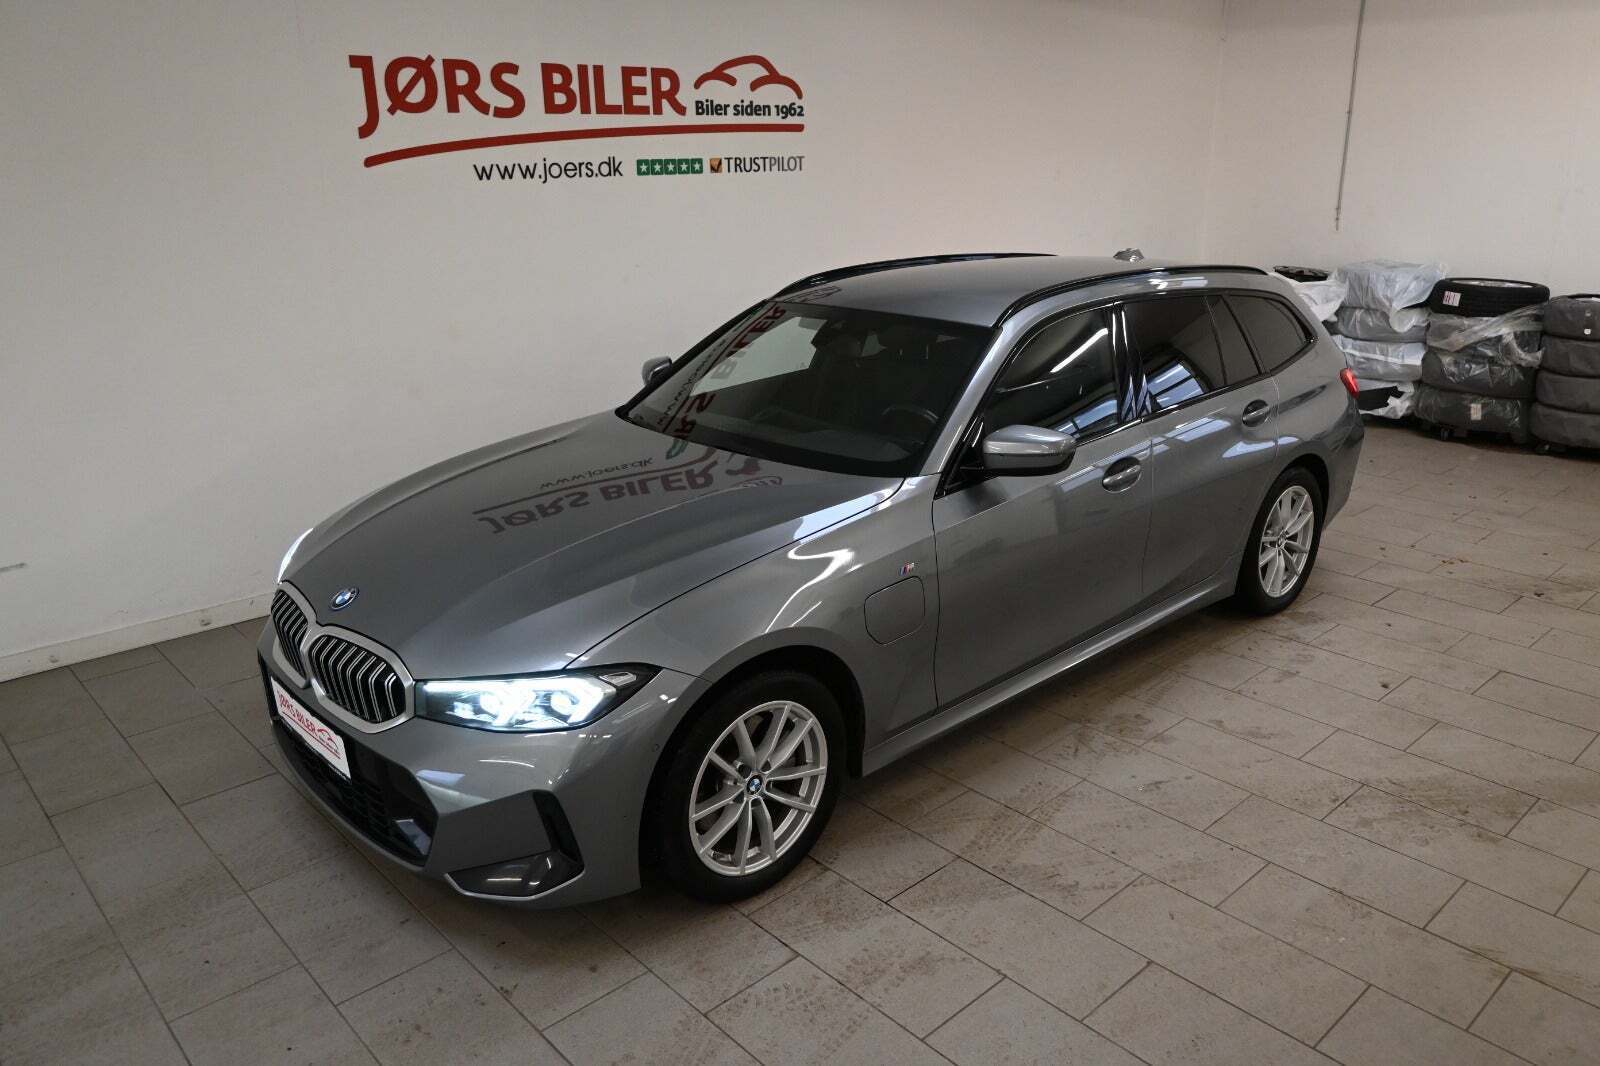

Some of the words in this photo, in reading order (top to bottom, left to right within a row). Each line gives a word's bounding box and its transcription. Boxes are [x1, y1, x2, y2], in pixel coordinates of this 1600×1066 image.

[348, 54, 526, 139] JØRS
[541, 62, 687, 117] BILER
[695, 99, 730, 117] Biler
[732, 99, 772, 117] siden
[774, 98, 805, 120] 1962
[473, 156, 624, 185] www.joers.dk
[724, 155, 805, 174] TRUSTPILOT
